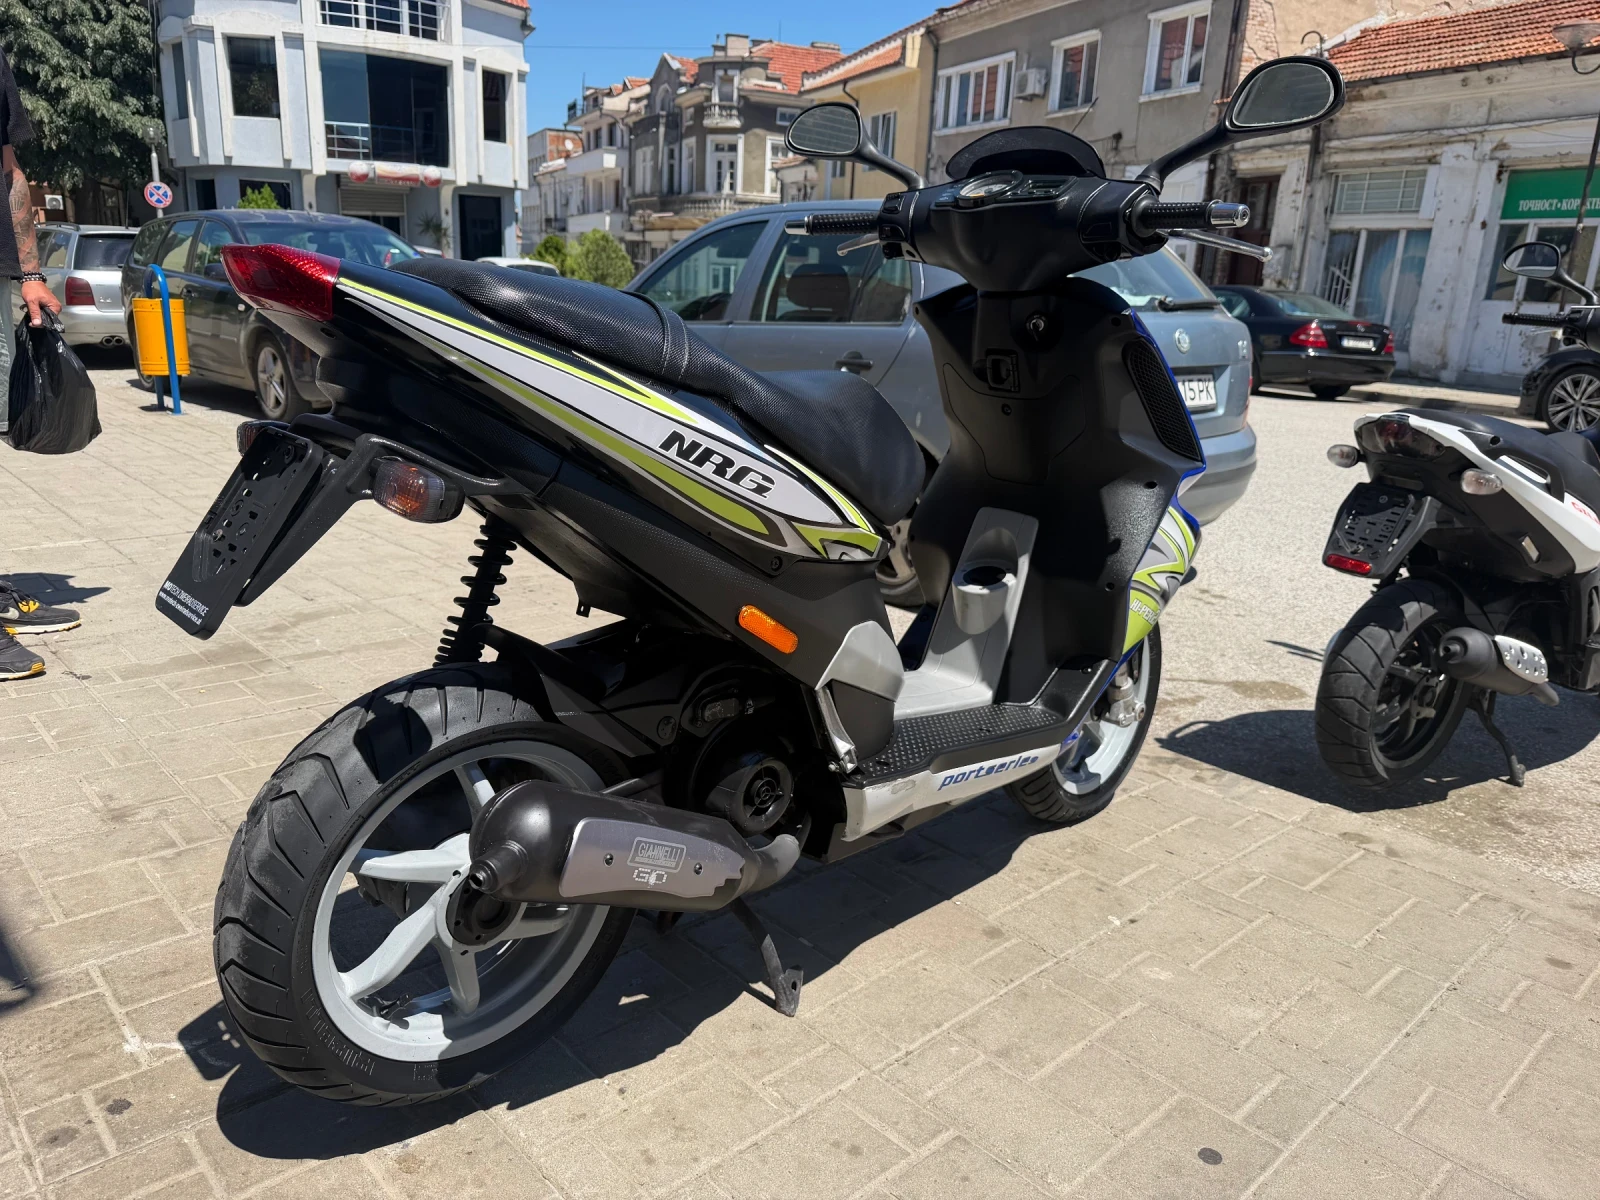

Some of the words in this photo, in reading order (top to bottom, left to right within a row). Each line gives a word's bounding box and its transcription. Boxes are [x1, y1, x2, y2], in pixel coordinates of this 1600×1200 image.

[1518, 199, 1558, 211] ТОЧНОСТ
[658, 429, 776, 499] NRG
[638, 842, 681, 862] GIANNELLI
